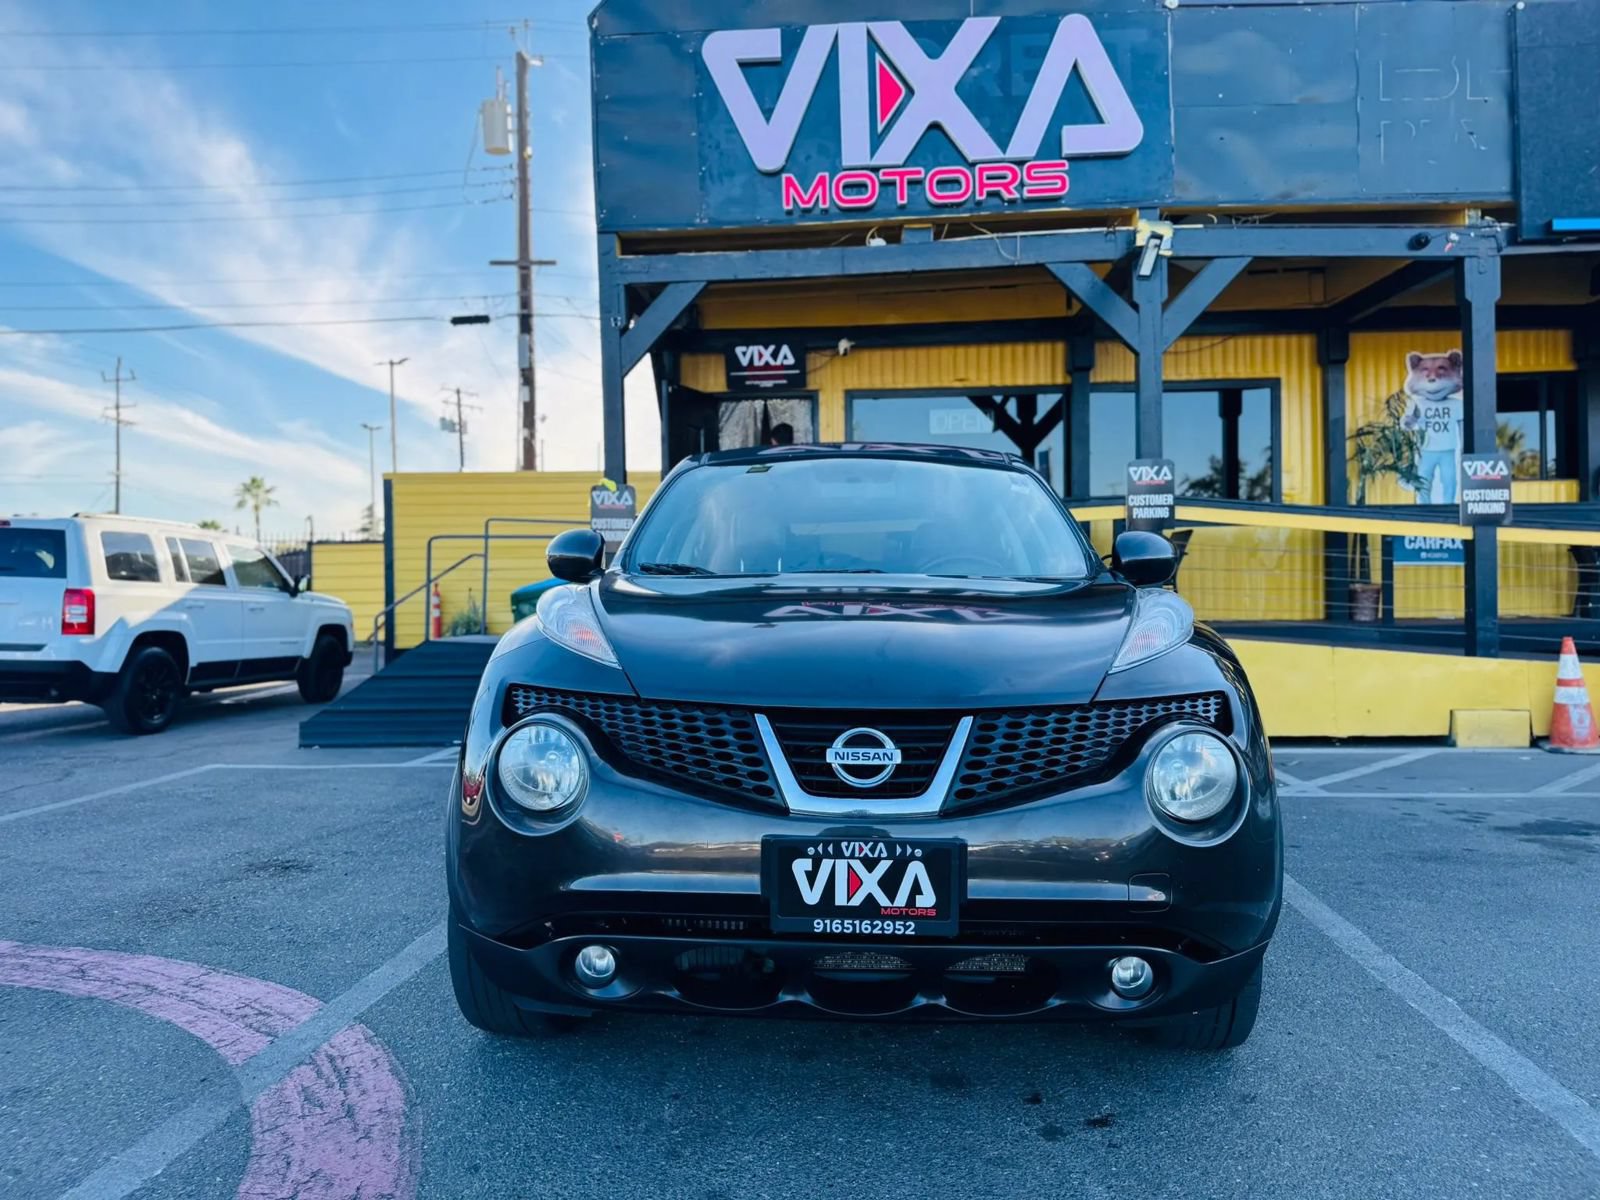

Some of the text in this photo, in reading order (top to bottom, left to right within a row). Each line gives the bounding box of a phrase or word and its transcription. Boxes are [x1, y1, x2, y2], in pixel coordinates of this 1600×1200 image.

[702, 13, 1144, 173] VIXA
[781, 160, 1070, 210] MOTORS
[734, 344, 796, 367] VIXA
[1424, 407, 1451, 420] CAR
[1425, 420, 1450, 433] FOX
[1128, 465, 1173, 481] VIXA
[1462, 460, 1509, 476] VIXA
[591, 490, 633, 505] VIXA
[1128, 494, 1174, 506] CUSTOMER
[1463, 488, 1510, 502] CUSTOMER
[1132, 506, 1170, 519] PARKING
[1467, 501, 1506, 515] PARKING
[1404, 536, 1464, 550] CARFAX
[834, 751, 894, 761] NISSAN
[840, 841, 888, 857] VIXA
[792, 858, 936, 907] VIXA
[880, 907, 937, 916] MOTORS
[813, 919, 916, 935] 9165162952
